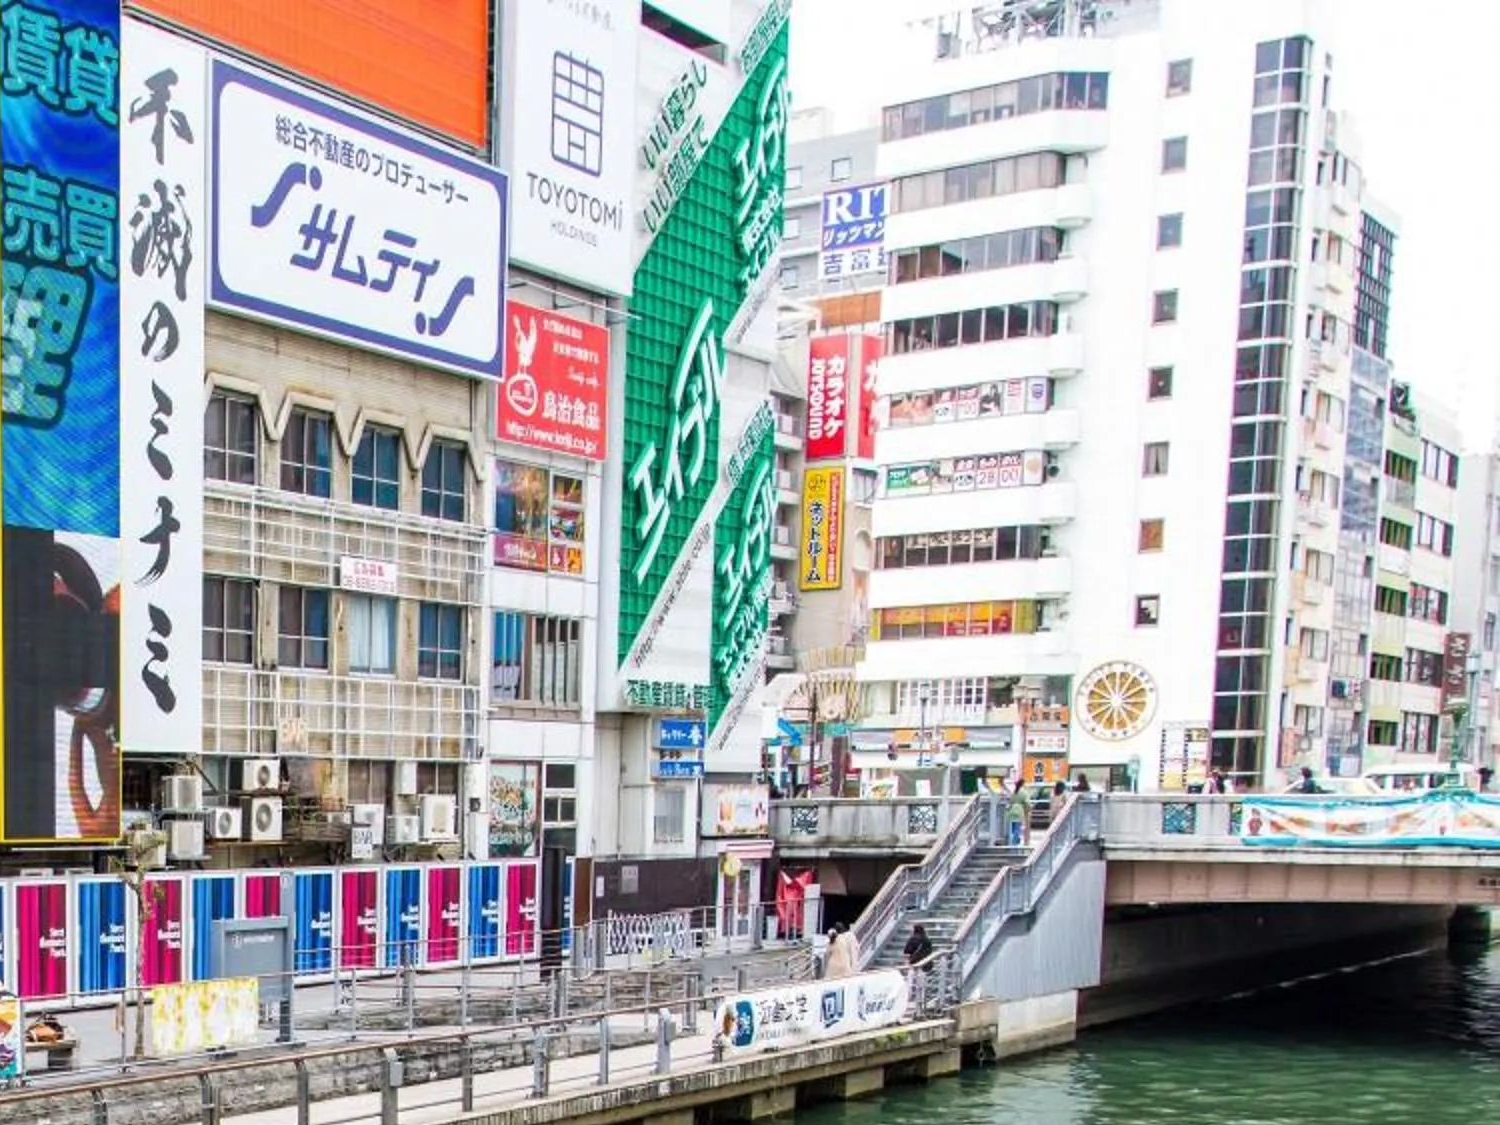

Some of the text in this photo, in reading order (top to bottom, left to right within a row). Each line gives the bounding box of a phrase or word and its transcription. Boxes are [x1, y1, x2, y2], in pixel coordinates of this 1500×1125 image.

[2, 4, 118, 124] 賃貸
[275, 113, 469, 206] 総合不動産のプロデューサー
[3, 168, 117, 280] 売買
[291, 204, 440, 303] サムティ
[128, 68, 194, 714] 不滅のミナミ
[826, 356, 845, 439] カラオケ
